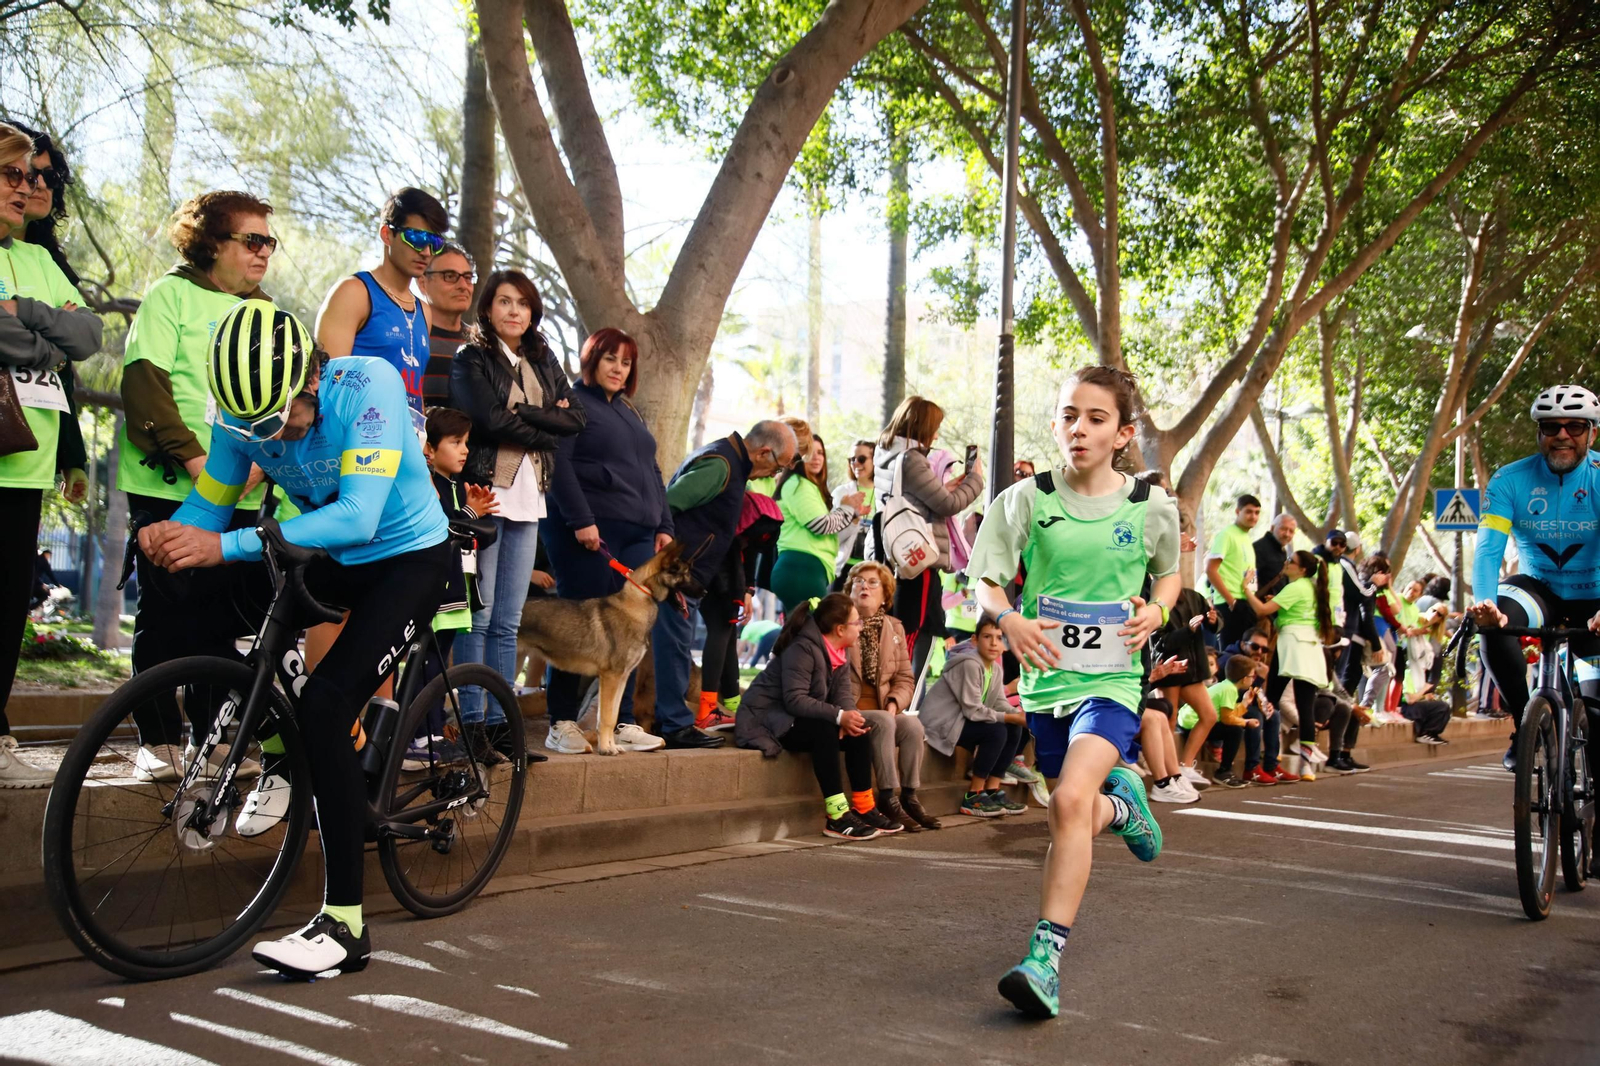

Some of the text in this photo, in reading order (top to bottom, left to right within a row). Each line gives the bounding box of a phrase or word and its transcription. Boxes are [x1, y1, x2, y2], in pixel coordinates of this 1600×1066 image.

[15, 365, 60, 391] 524
[355, 466, 386, 474] Europack
[1520, 519, 1599, 532] BIKESTORE
[1041, 605, 1060, 615] contra
[1068, 611, 1092, 619] cáncer
[1061, 624, 1102, 650] 82
